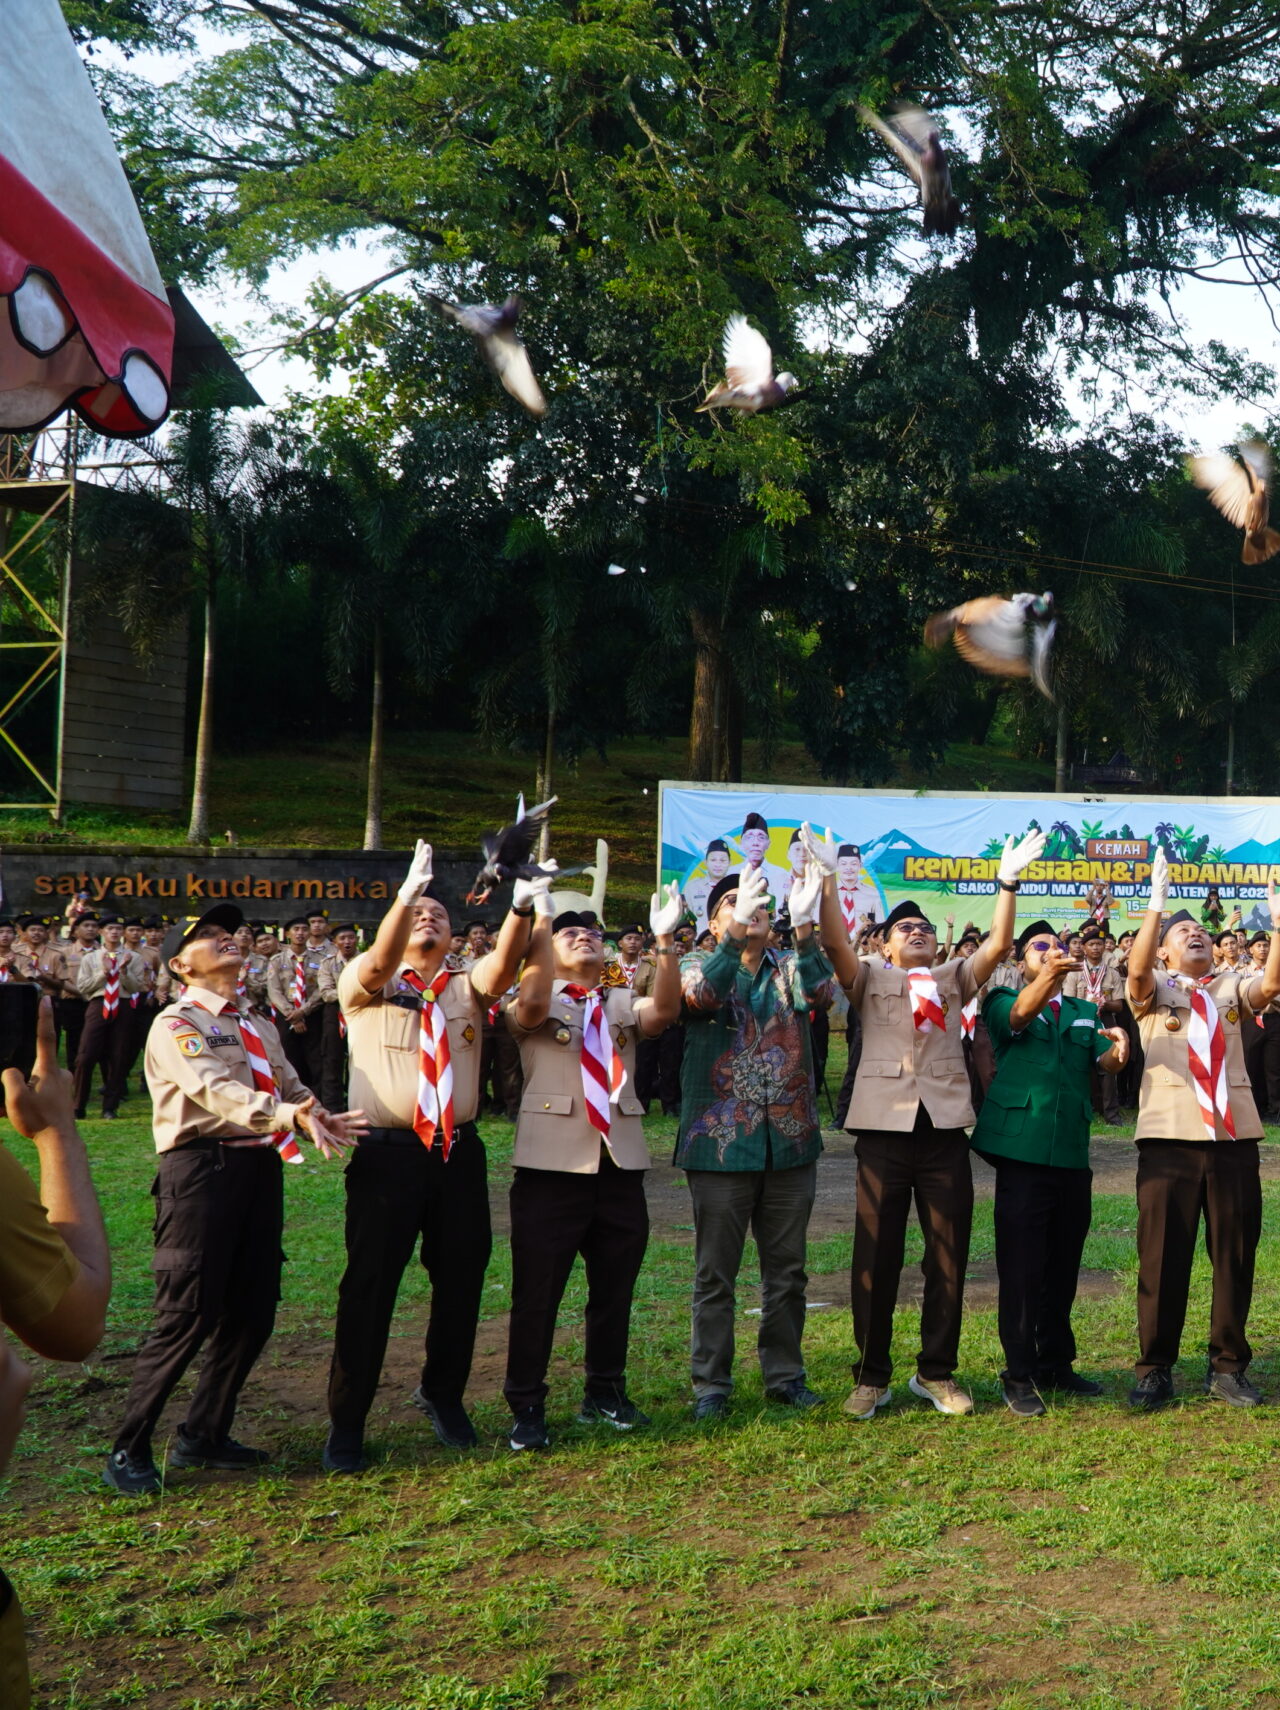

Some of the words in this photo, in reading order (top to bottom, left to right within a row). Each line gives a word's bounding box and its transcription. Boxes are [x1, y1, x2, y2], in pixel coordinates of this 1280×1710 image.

[1095, 843, 1141, 856] KEMAH
[34, 872, 177, 902] satyaku
[957, 882, 995, 894] SAKO
[1015, 883, 1048, 895] NDU
[1114, 884, 1136, 897] NU
[1138, 885, 1178, 898] JAA
[1181, 886, 1235, 899] TENAH
[1239, 888, 1269, 899] 2025
